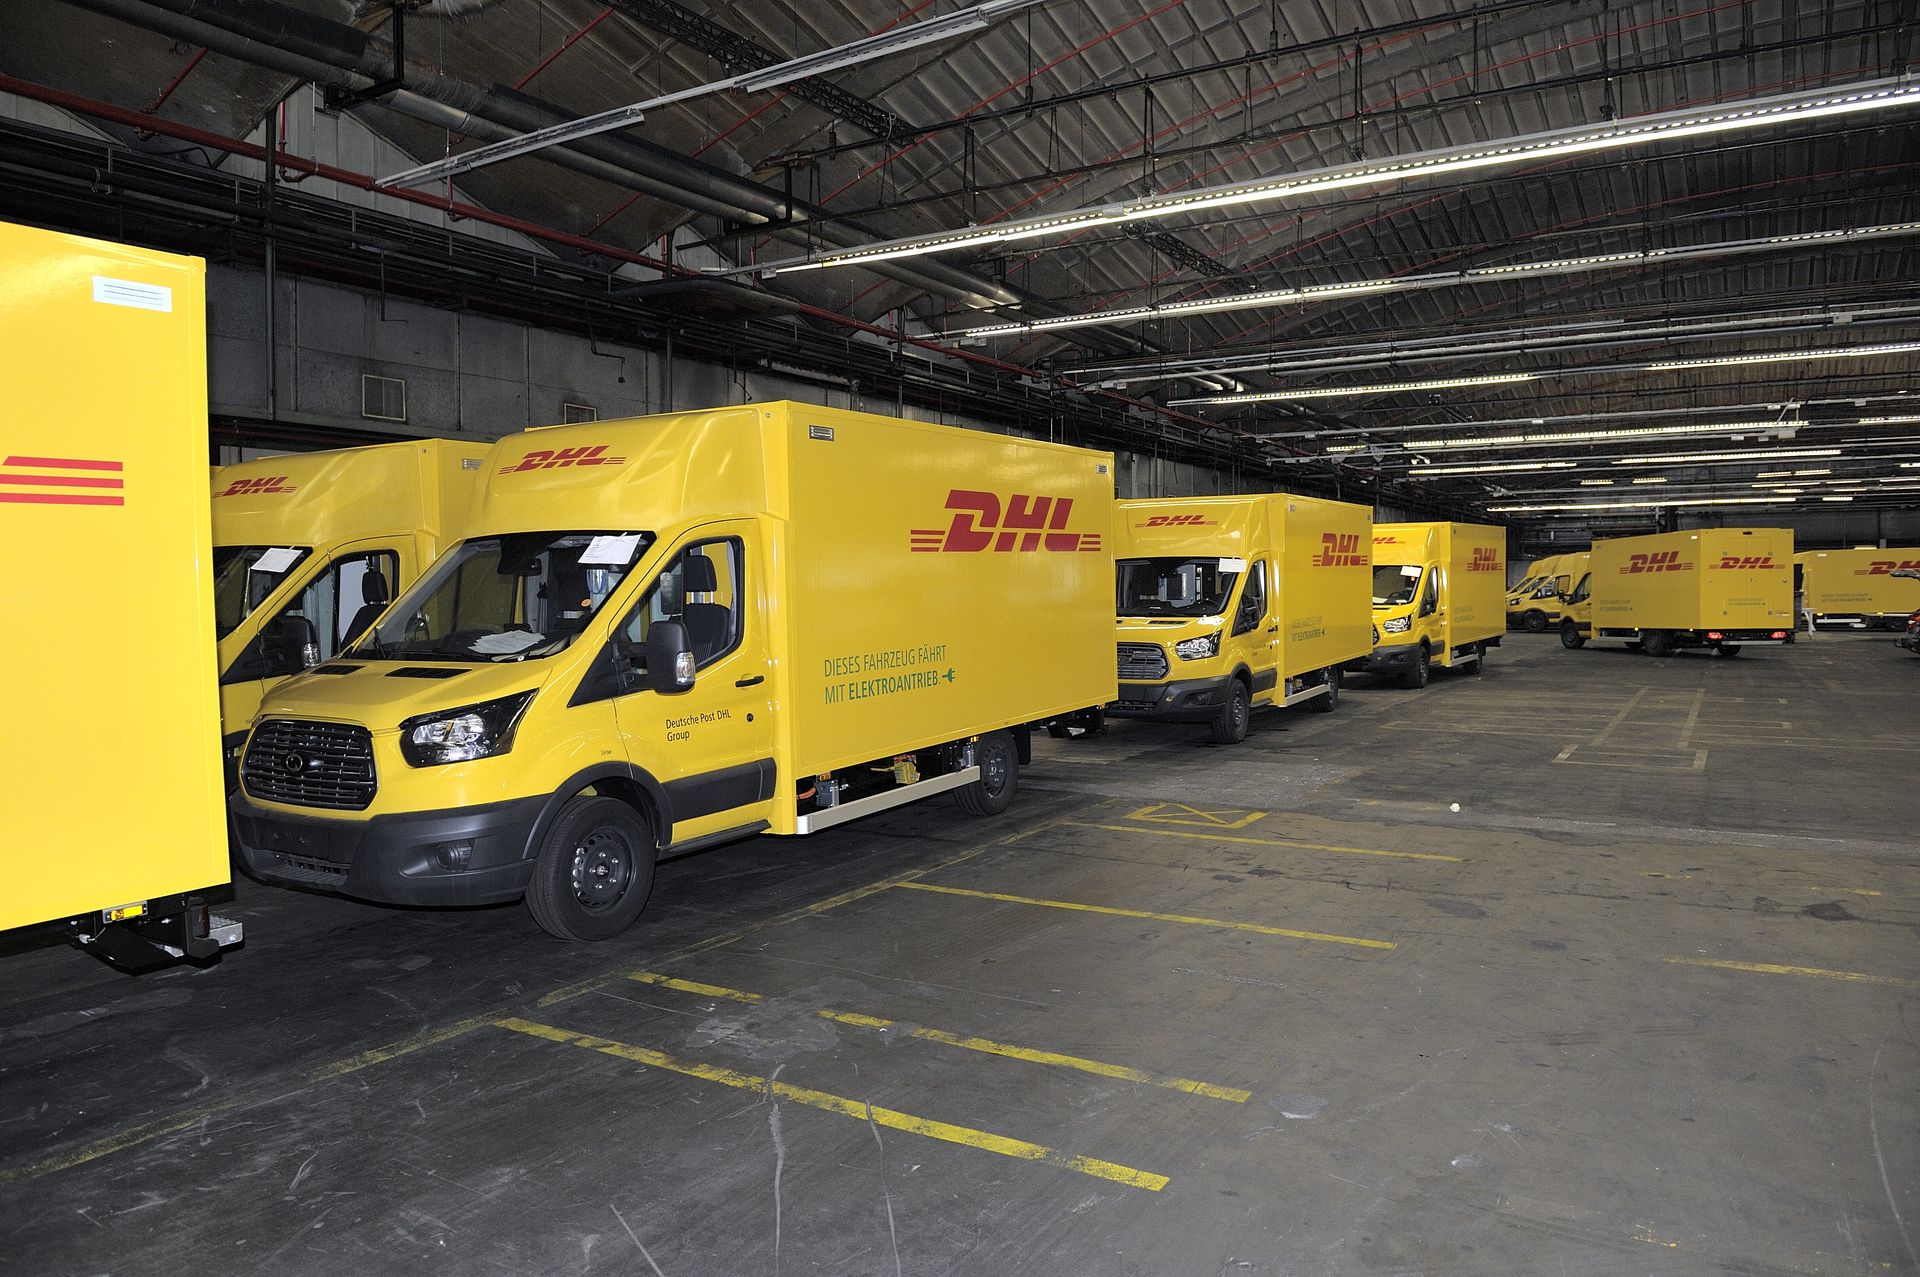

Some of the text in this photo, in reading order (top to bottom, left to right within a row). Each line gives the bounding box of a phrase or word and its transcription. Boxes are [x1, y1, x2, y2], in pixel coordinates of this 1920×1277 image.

[513, 445, 609, 473] DHL
[222, 476, 288, 497] DHL
[942, 489, 1081, 552] DHL
[1146, 515, 1205, 527] DHL
[1320, 533, 1361, 566] DHL
[1371, 536, 1397, 544] HL
[1472, 547, 1499, 572] DHL
[1629, 551, 1682, 573] DHL
[1720, 557, 1774, 569] DHL
[824, 644, 946, 677] DIESES FAHRZEUG FÄHRT
[825, 670, 941, 704] MIT ELEKTROANTRIEB.
[665, 709, 731, 729] Deutsche Post DHL
[667, 730, 690, 742] Group
